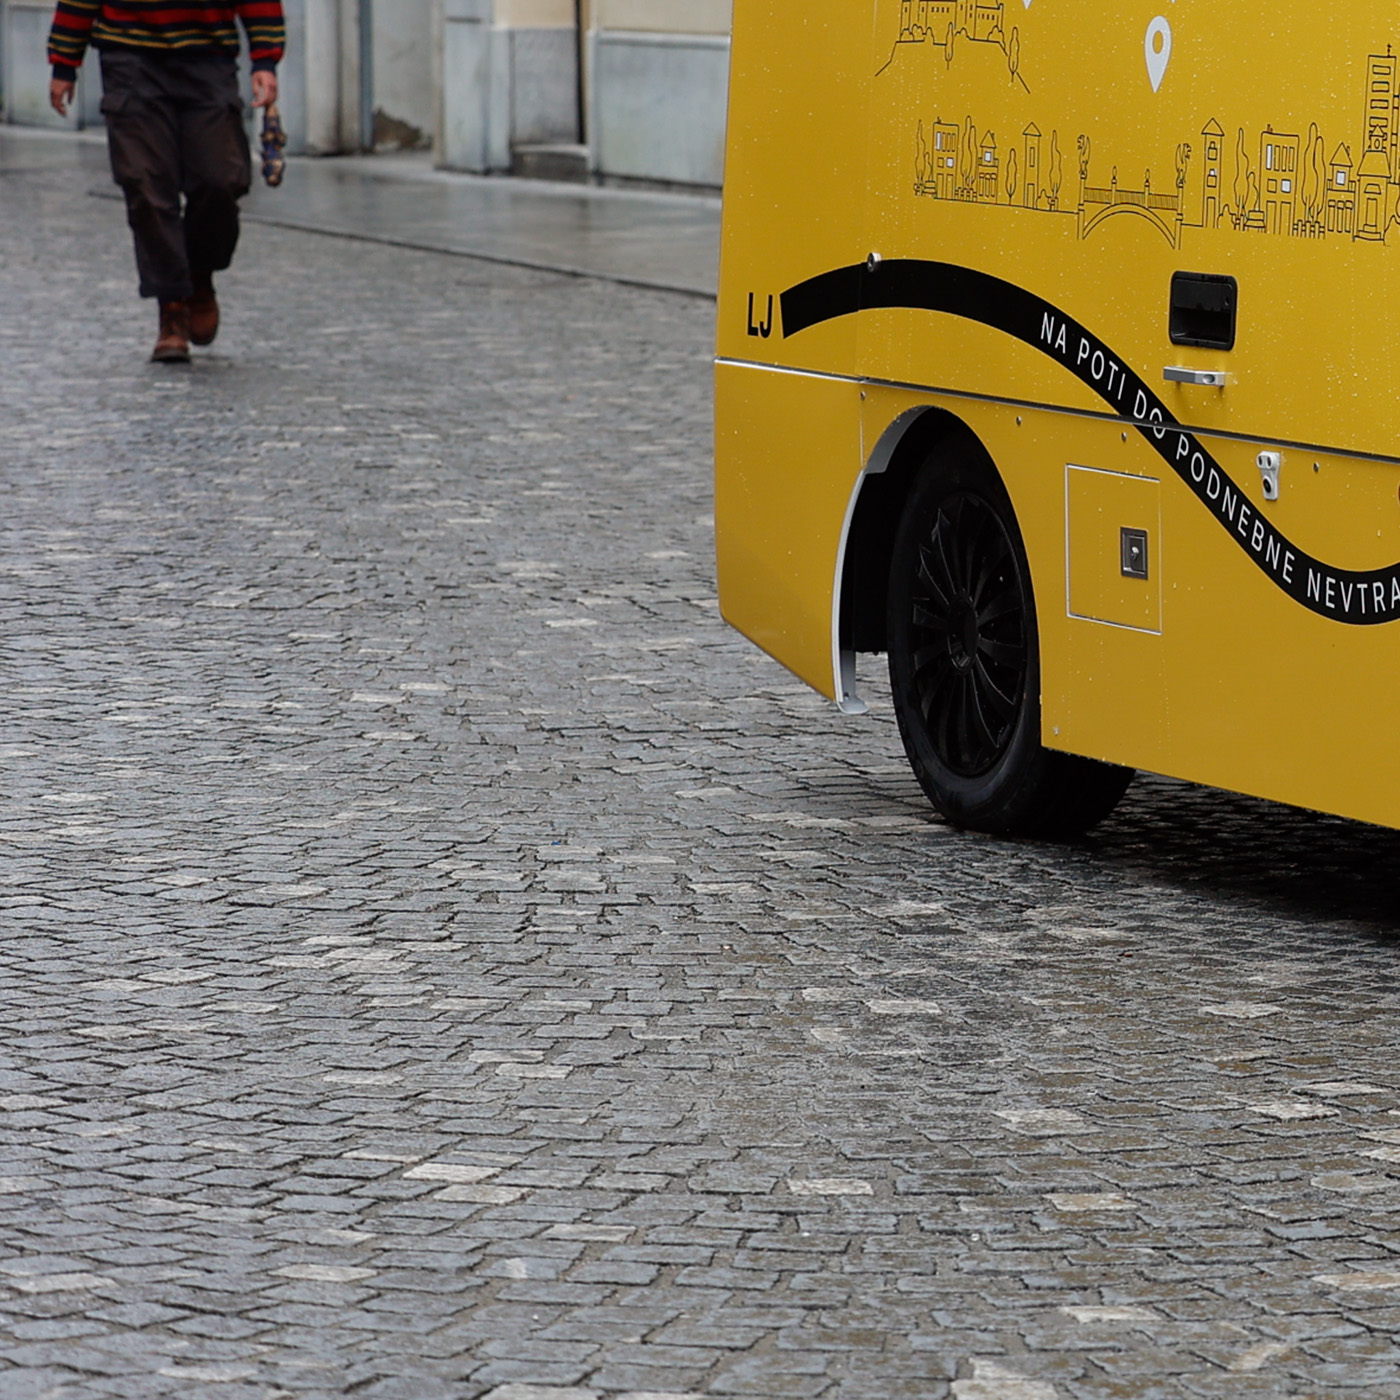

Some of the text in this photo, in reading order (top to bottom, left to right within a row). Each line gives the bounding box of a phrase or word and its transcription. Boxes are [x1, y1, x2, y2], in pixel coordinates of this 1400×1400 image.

[746, 291, 774, 339] LJ
[1039, 311, 1067, 355] NA
[1076, 335, 1124, 401] POTI
[1132, 388, 1166, 439] DO
[1175, 432, 1295, 585] PODNEBNE
